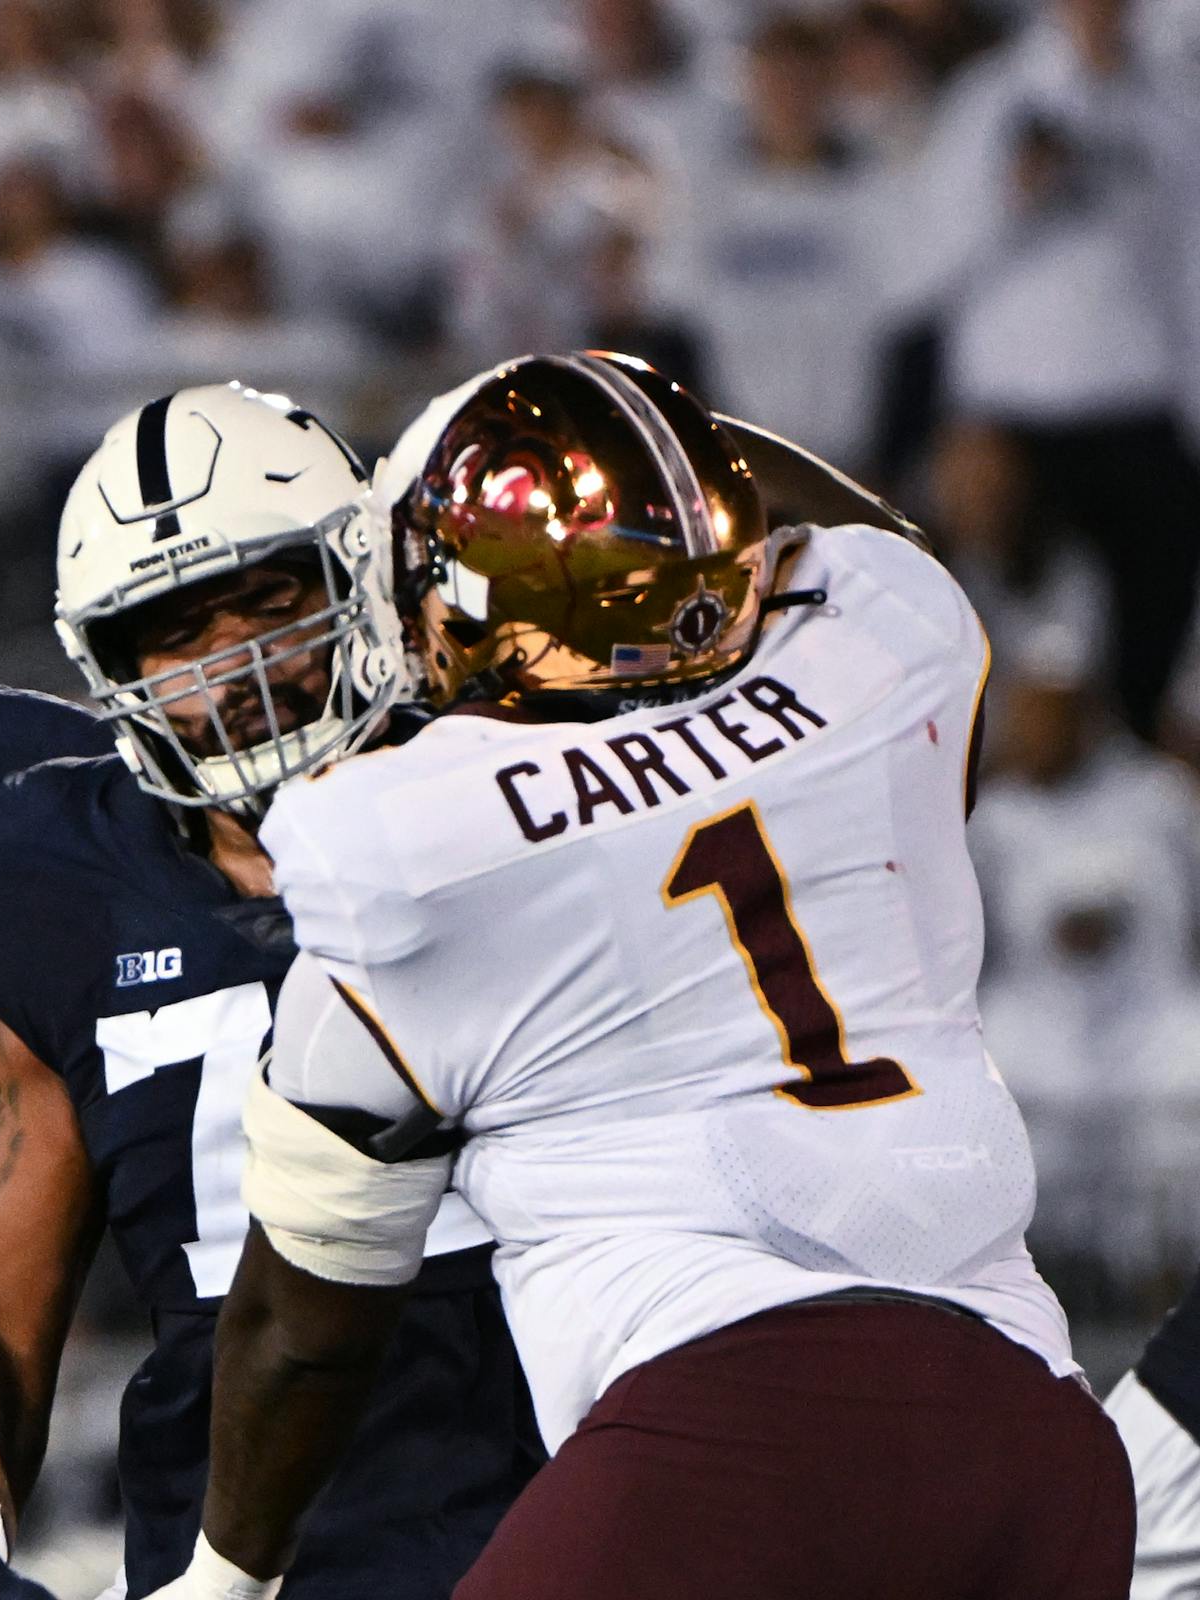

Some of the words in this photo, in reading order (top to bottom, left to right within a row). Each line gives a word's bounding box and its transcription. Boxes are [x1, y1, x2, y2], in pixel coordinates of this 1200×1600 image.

[167, 536, 210, 558] STATE
[495, 675, 828, 843] CARTER
[660, 797, 924, 1110] 1
